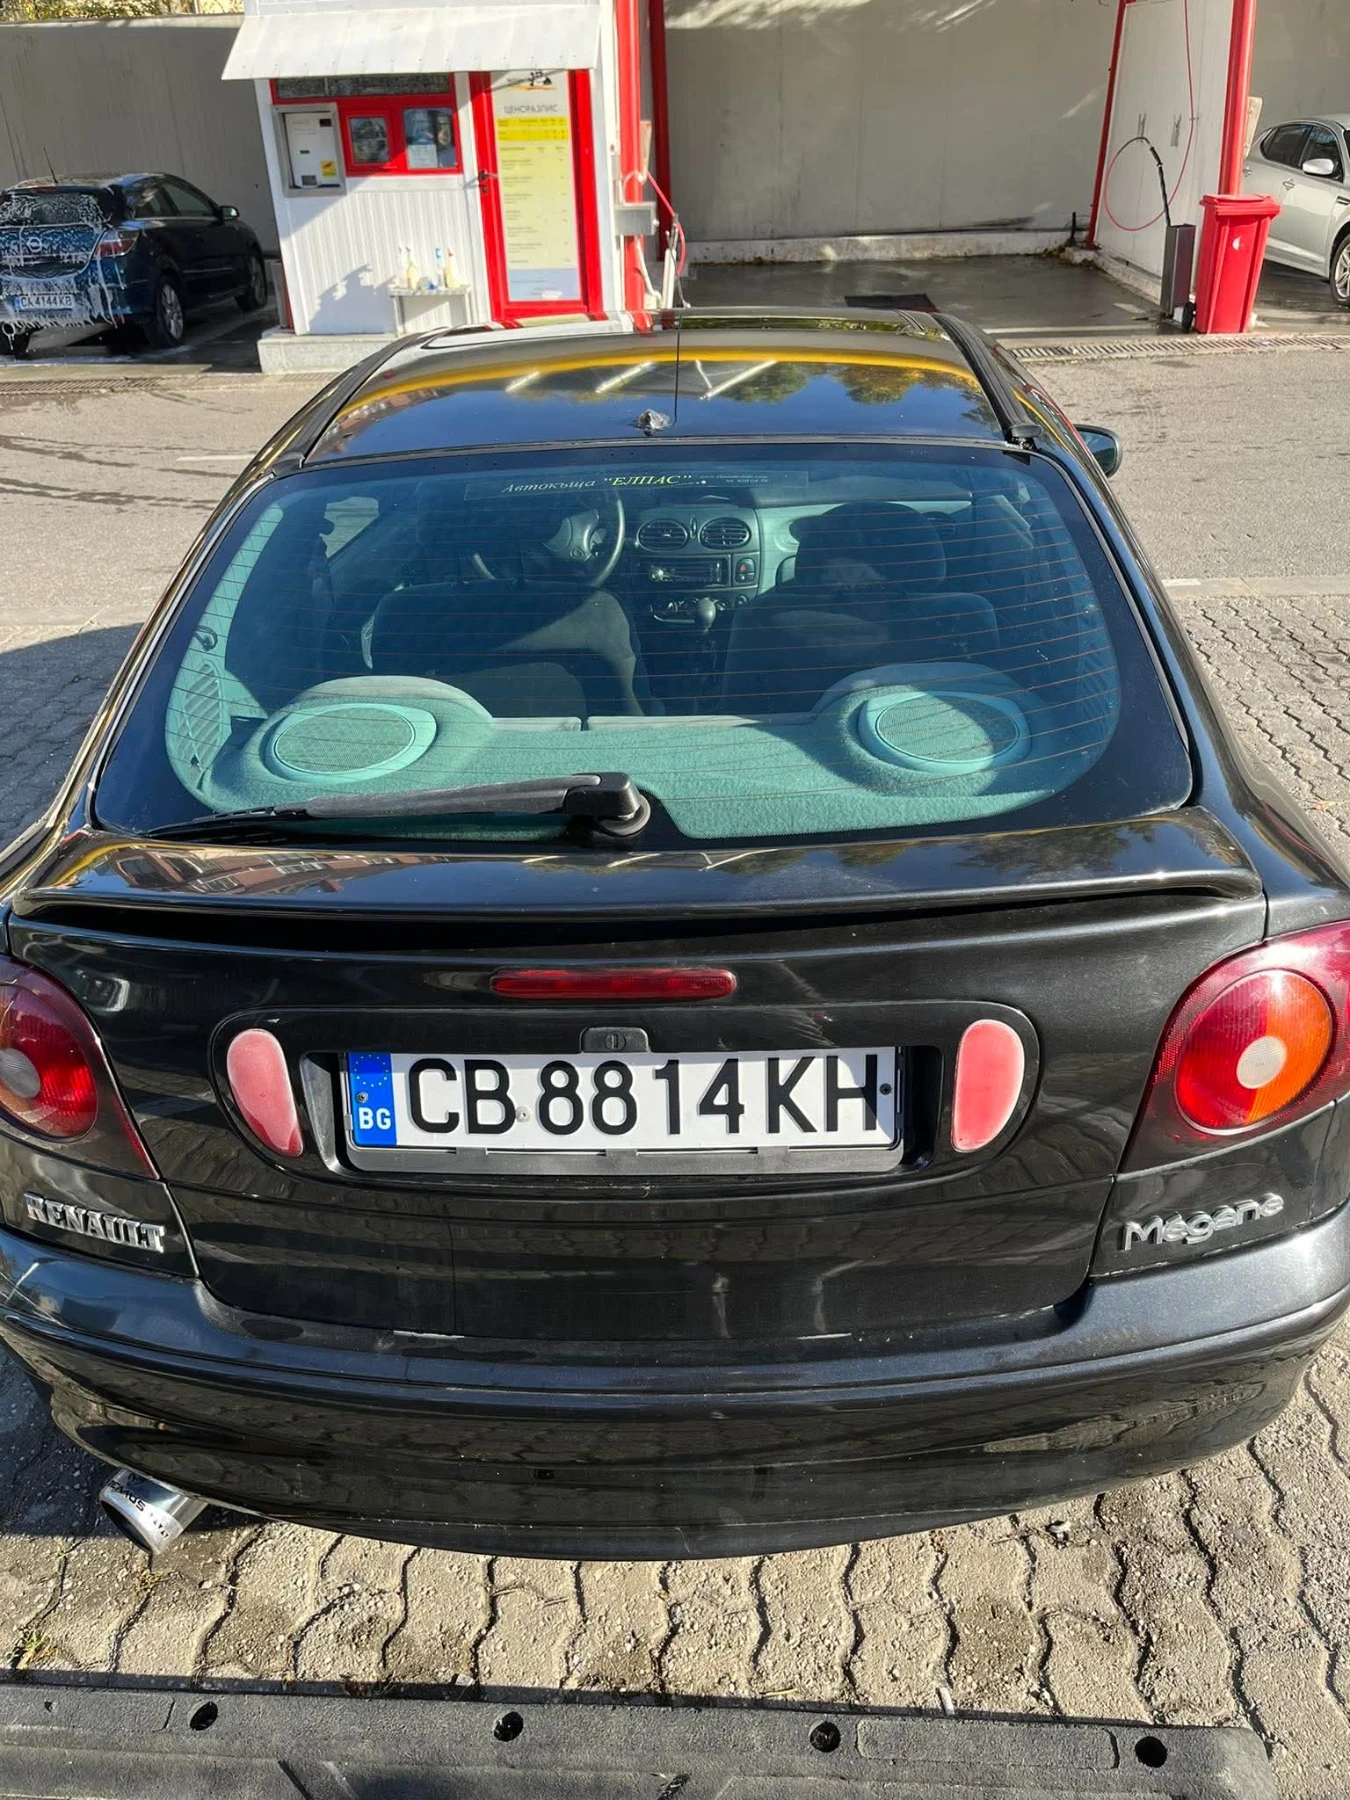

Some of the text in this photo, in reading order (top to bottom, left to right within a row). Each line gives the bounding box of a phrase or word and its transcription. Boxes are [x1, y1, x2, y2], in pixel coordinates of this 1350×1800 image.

[502, 480, 596, 494] Автокъща
[410, 1053, 879, 1136] CB 8814 KH
[359, 1106, 393, 1131] BG
[23, 1190, 166, 1254] RENAULT
